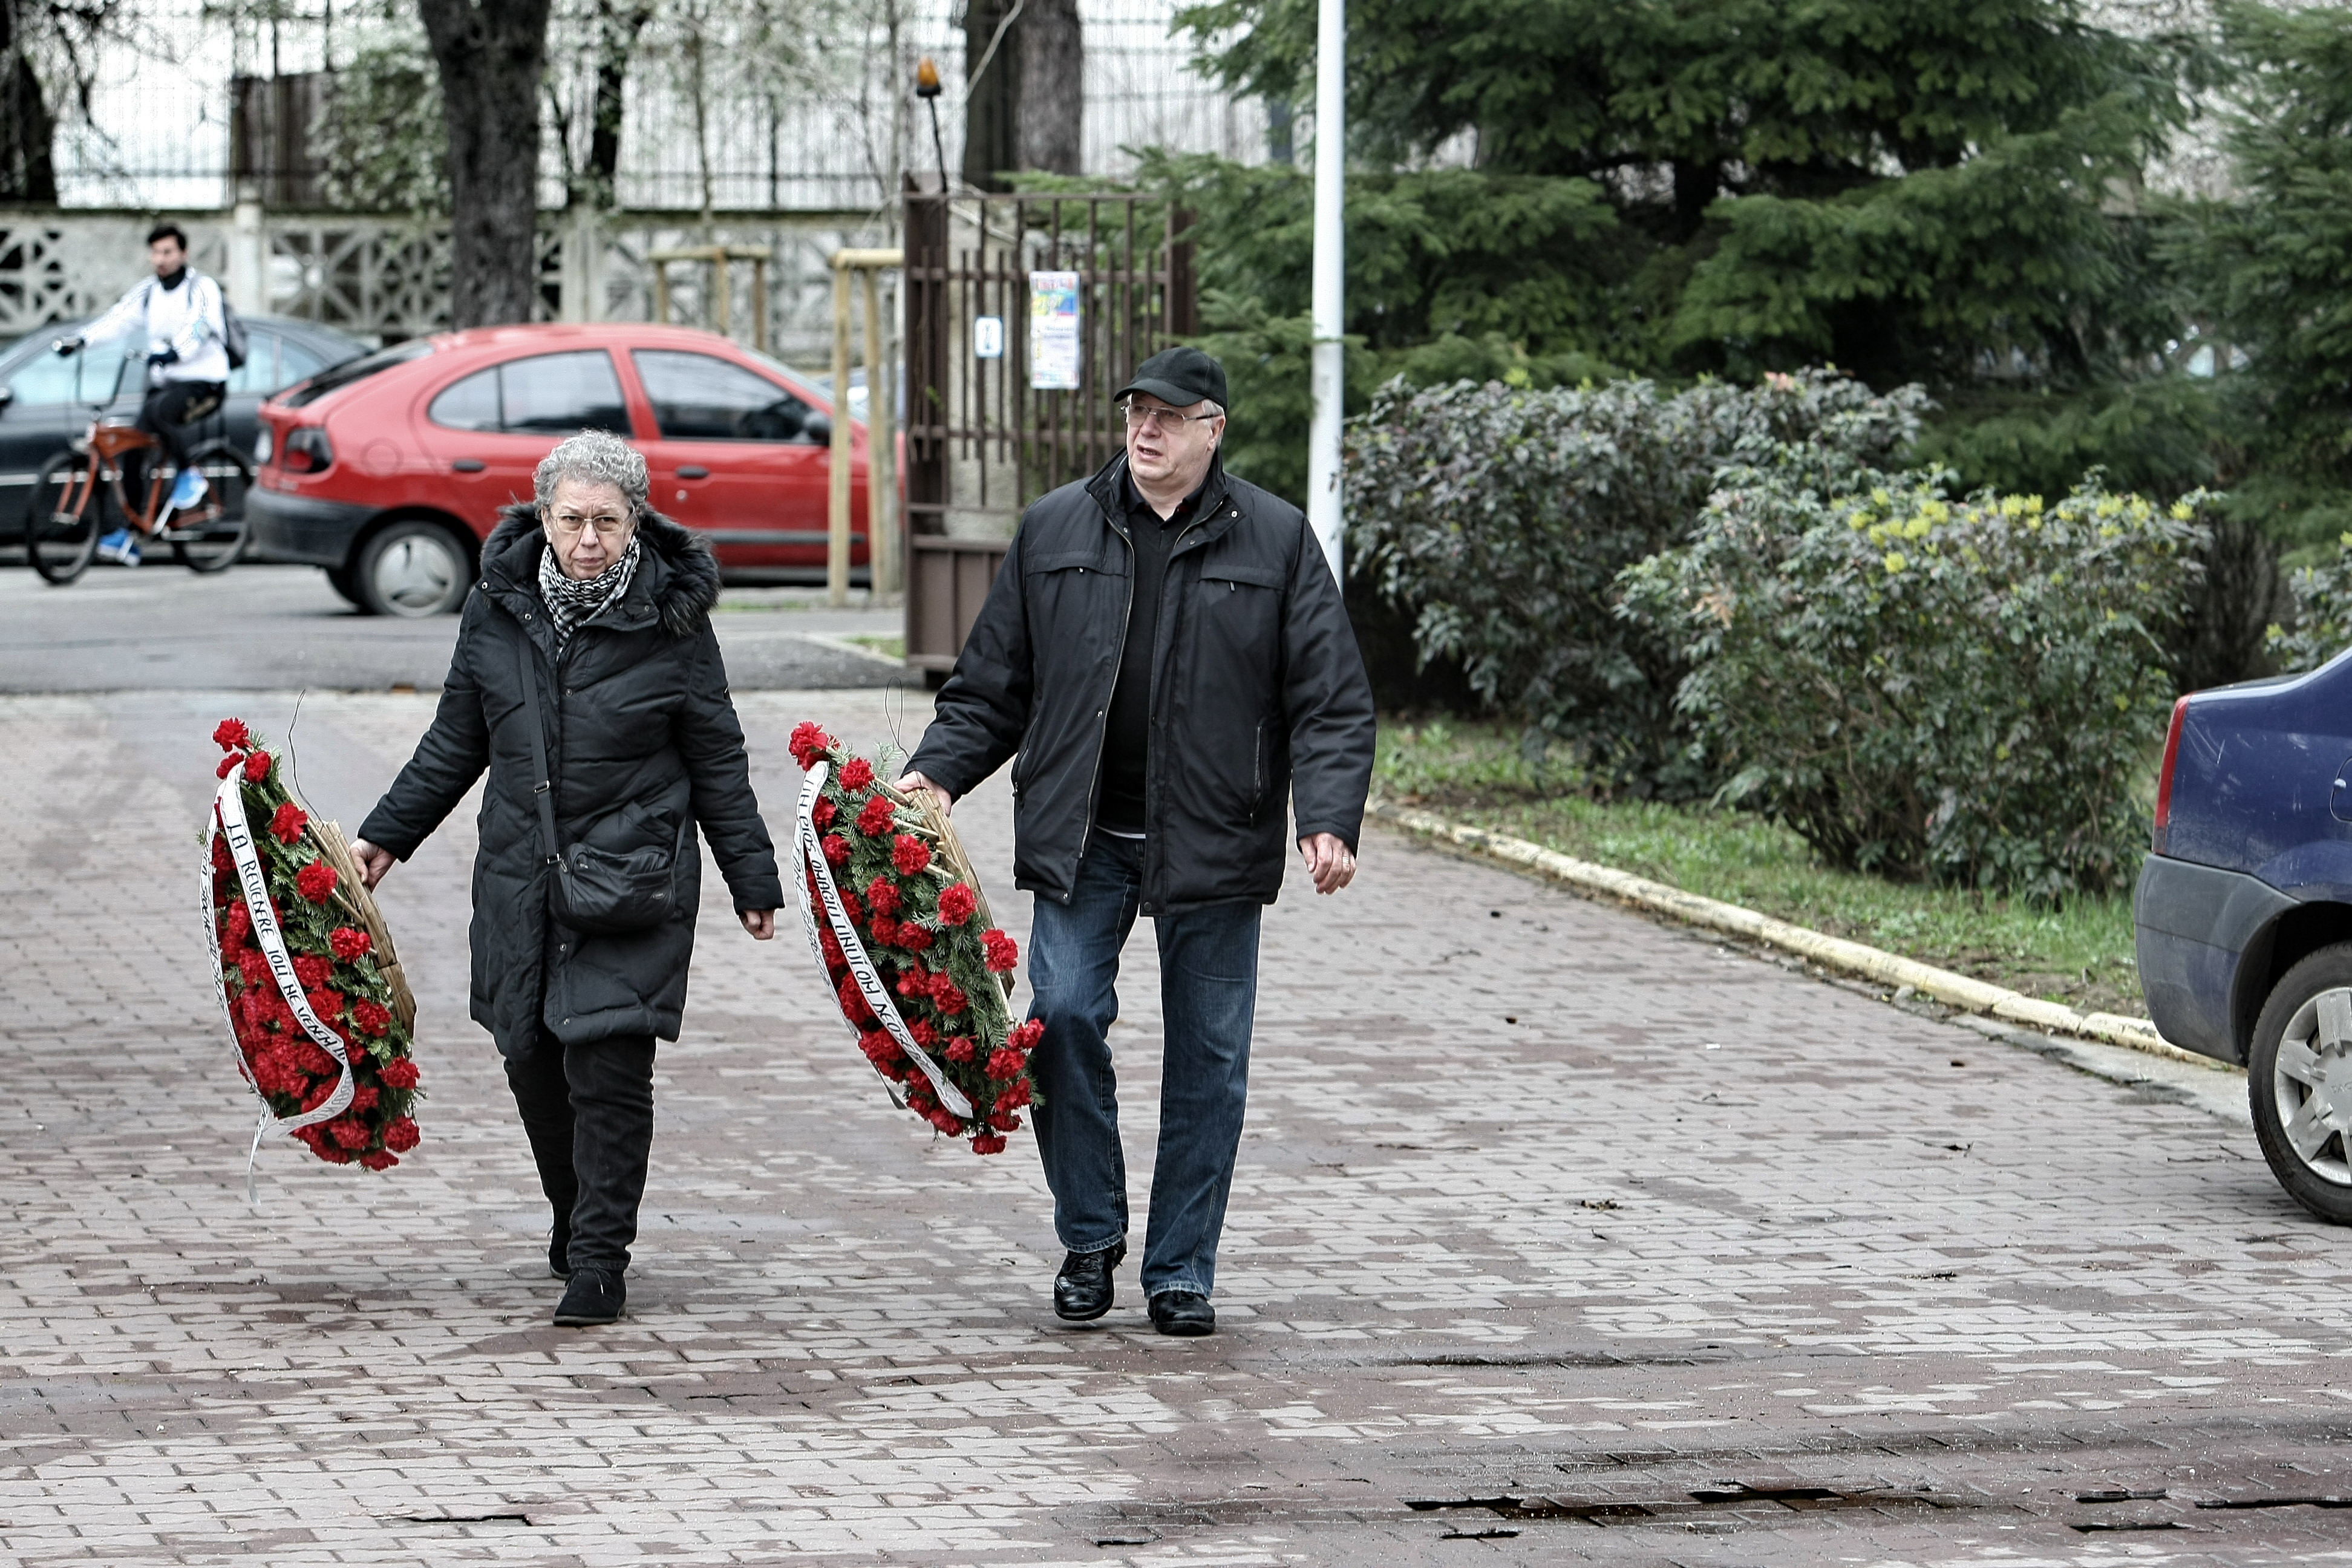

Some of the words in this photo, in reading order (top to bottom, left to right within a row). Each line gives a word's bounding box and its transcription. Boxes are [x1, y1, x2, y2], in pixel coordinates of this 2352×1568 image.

[226, 823, 249, 850] LA
[240, 860, 275, 940] REVEDERE
[283, 984, 302, 1007] NE
[297, 1006, 339, 1048] VEDEM
[811, 860, 841, 918] OMAGIU
[835, 925, 864, 965] UNUI
[855, 970, 881, 995] OM
